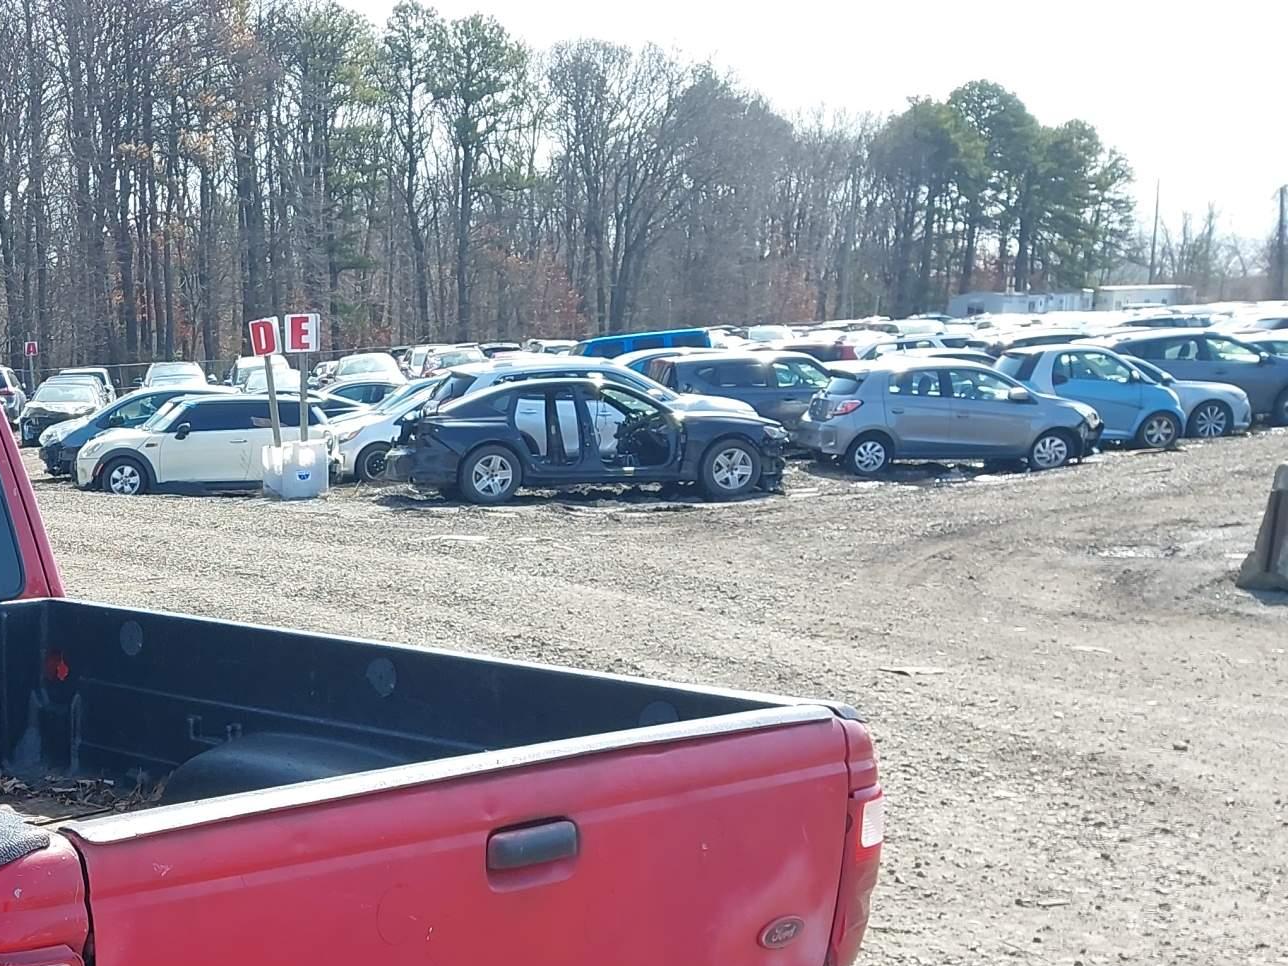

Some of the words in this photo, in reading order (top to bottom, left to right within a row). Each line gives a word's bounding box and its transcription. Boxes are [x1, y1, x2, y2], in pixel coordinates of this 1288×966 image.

[26, 342, 37, 355] A
[250, 320, 276, 355] D
[290, 316, 310, 350] E
